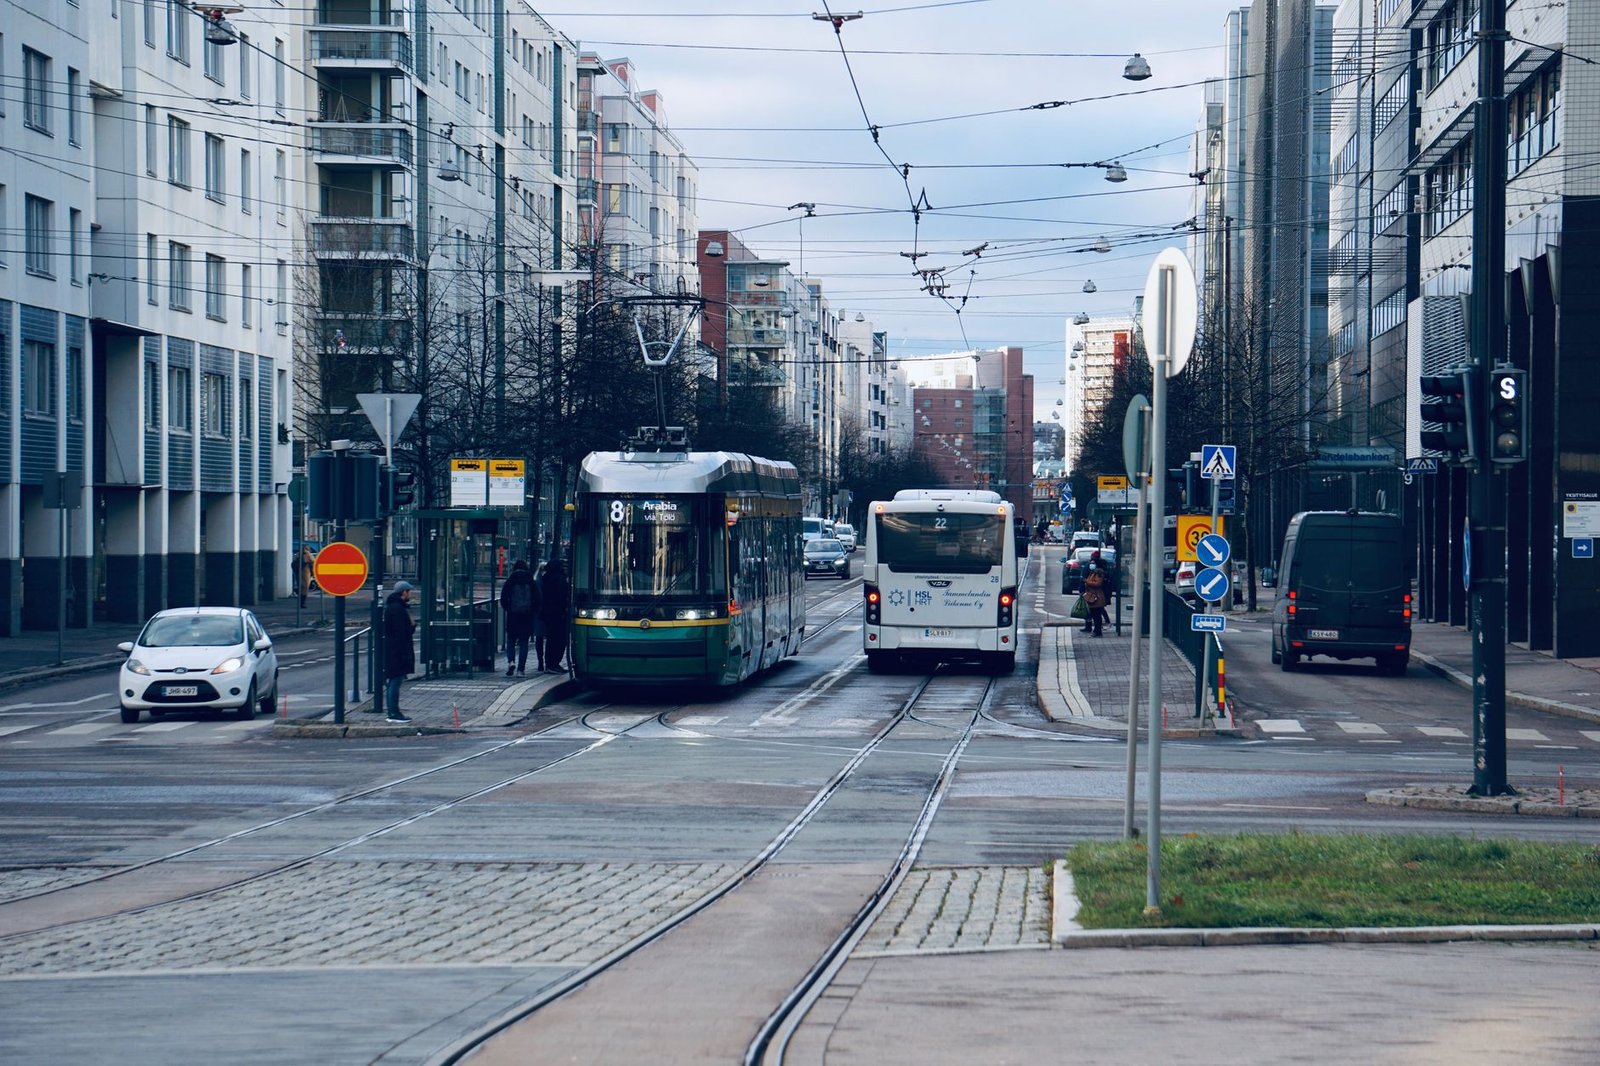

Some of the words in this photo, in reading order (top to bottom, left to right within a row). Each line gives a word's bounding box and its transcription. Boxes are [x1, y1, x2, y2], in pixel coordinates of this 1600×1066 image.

[1499, 377, 1515, 400] S
[610, 500, 624, 522] 8
[643, 501, 677, 511] Arabia
[644, 513, 656, 521] via
[935, 517, 947, 529] 22
[990, 575, 999, 583] 28
[915, 590, 932, 599] HSL
[973, 598, 984, 609] Oy
